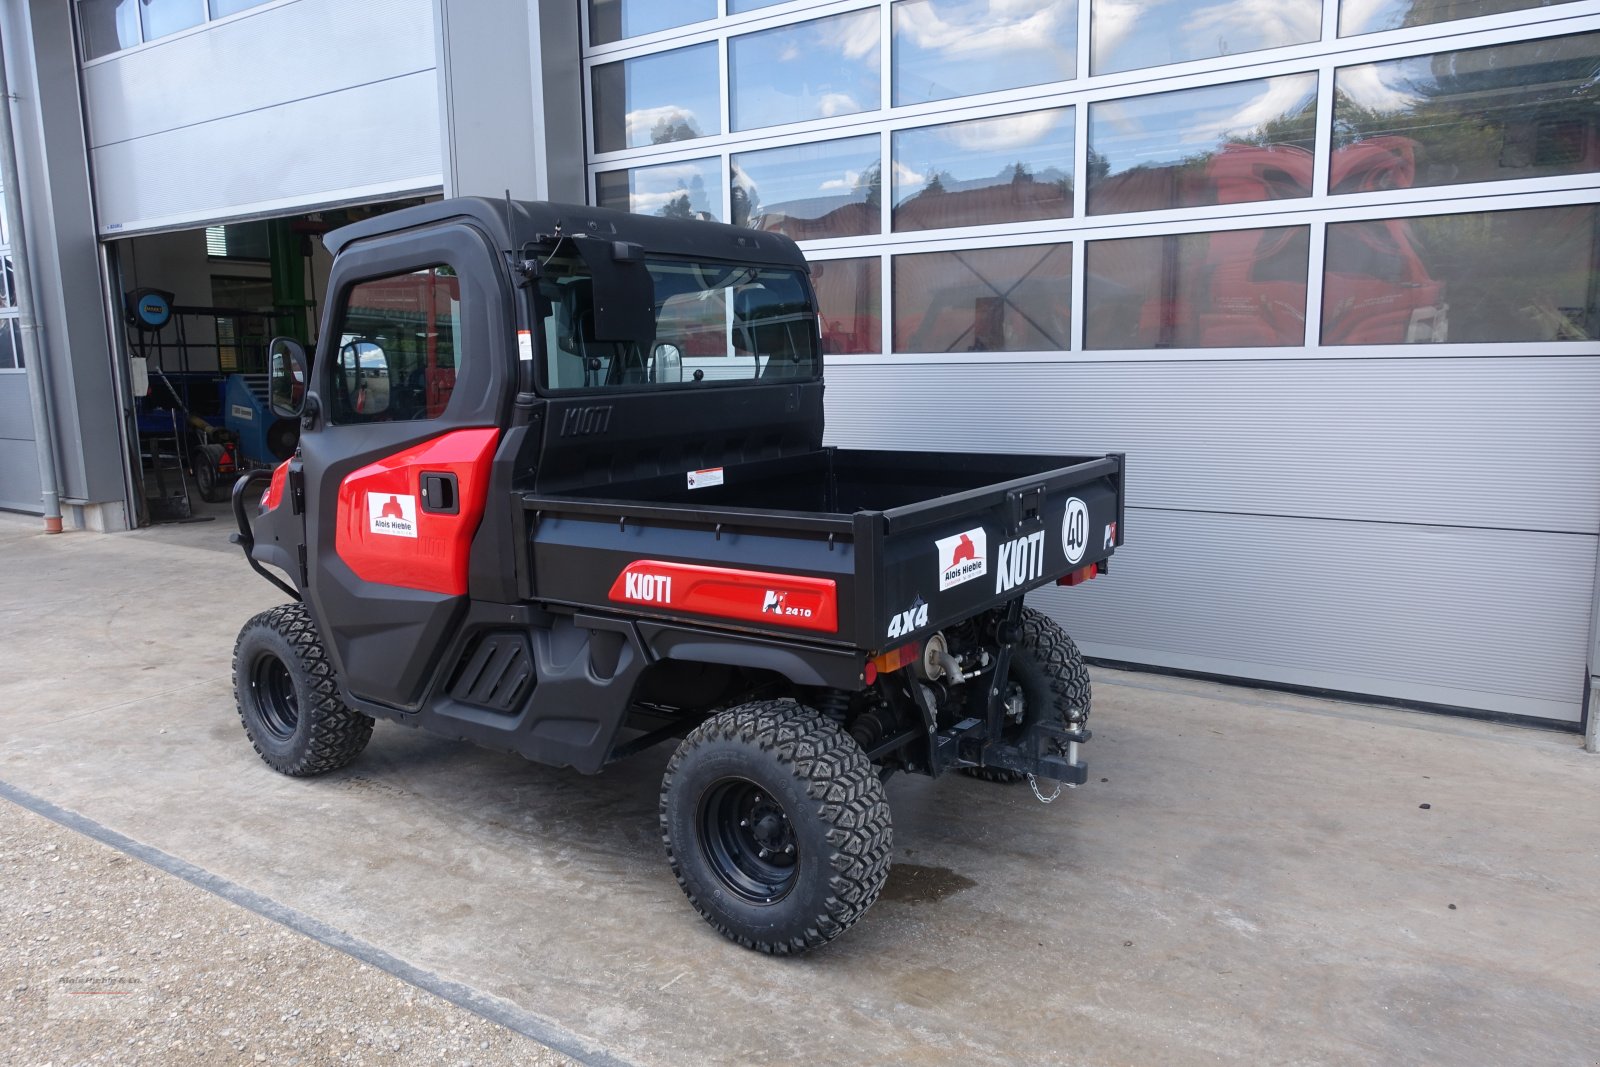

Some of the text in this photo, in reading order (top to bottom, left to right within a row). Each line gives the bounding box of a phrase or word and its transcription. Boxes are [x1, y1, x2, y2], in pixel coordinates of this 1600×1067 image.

[375, 520, 412, 531] Alois Hieble
[1067, 509, 1084, 550] 40
[945, 567, 961, 581] Alois
[962, 560, 982, 575] Hieble
[995, 530, 1045, 594] KIOTI
[625, 572, 672, 603] KIOTI
[785, 607, 812, 618] 2410
